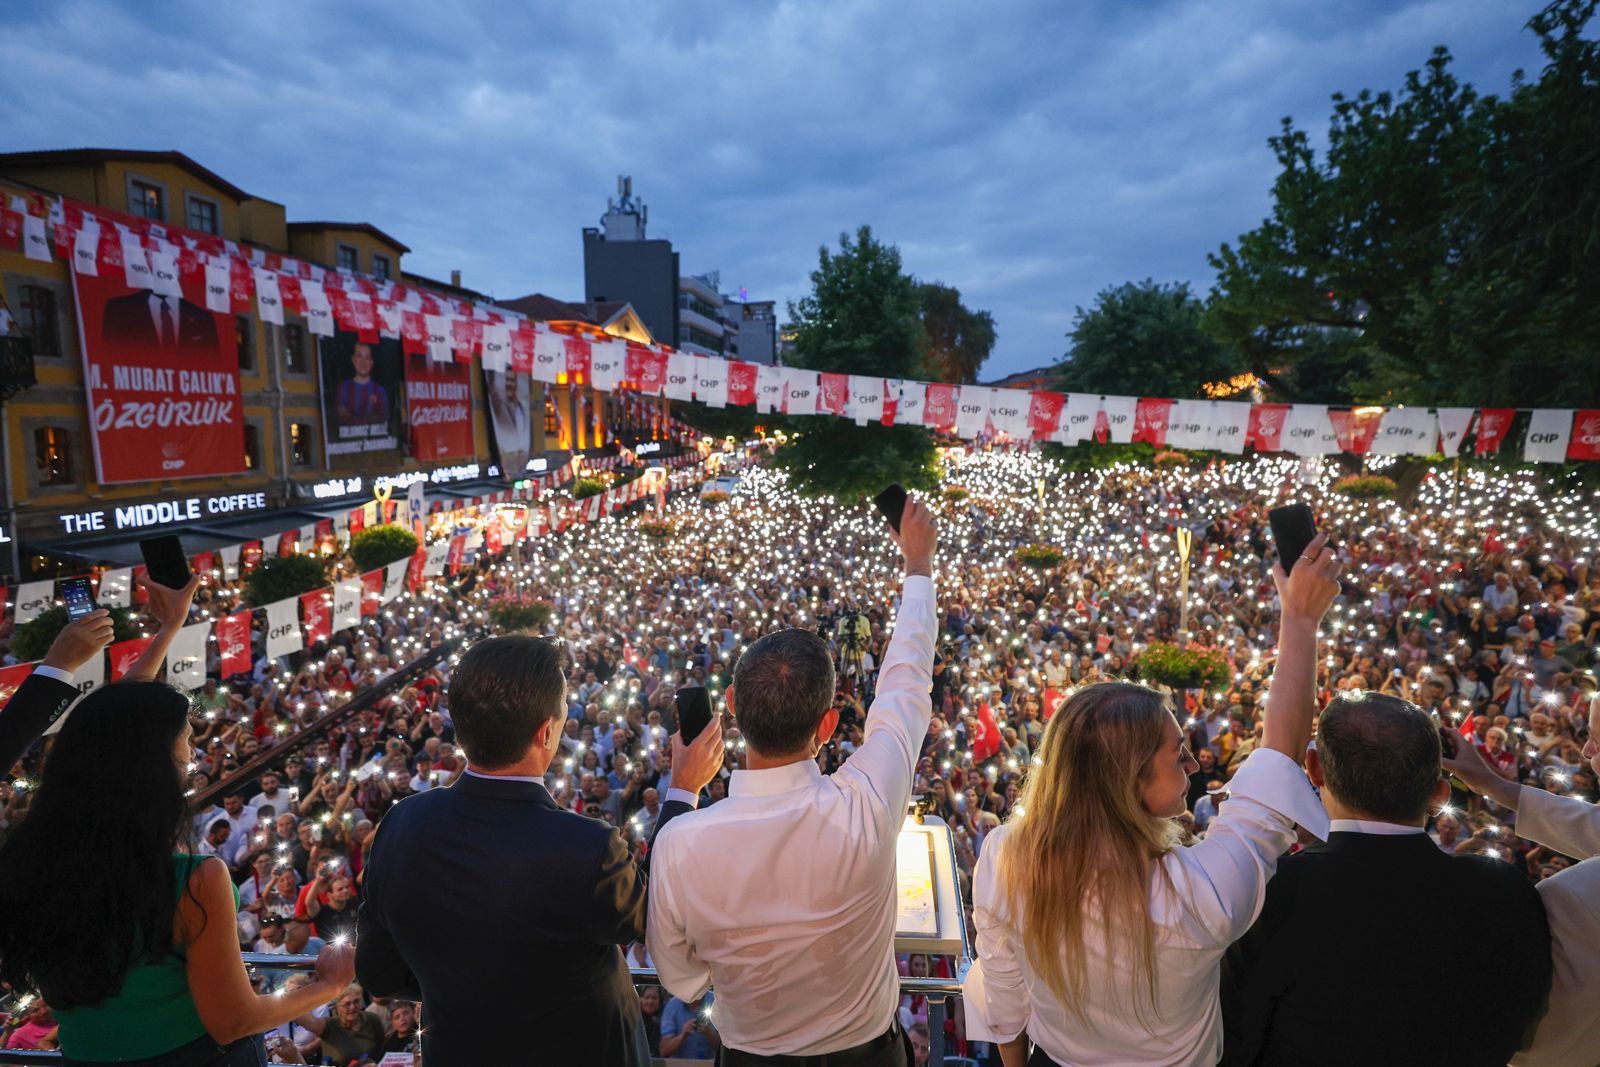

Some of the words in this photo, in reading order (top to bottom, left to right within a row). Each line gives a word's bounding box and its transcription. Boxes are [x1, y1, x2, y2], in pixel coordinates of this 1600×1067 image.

[113, 365, 175, 393] MURAT
[669, 374, 687, 385] CHP
[699, 378, 719, 389] CHP
[763, 385, 779, 393] CHP
[791, 389, 811, 399] CHP
[858, 394, 878, 404] CHP
[95, 397, 234, 432] ÖZGÜRLÜK
[928, 405, 945, 415] CHP
[961, 404, 982, 415] CHP
[998, 407, 1019, 417] CHP
[1034, 409, 1052, 420] CHP
[1070, 415, 1089, 425] CHP
[1386, 426, 1414, 437] CHP
[1529, 432, 1560, 444] CHP
[162, 459, 186, 470] CHP
[60, 511, 106, 534] THE
[115, 498, 202, 530] MIDDLE
[208, 492, 267, 514] COFFEE
[270, 622, 293, 640] CHP
